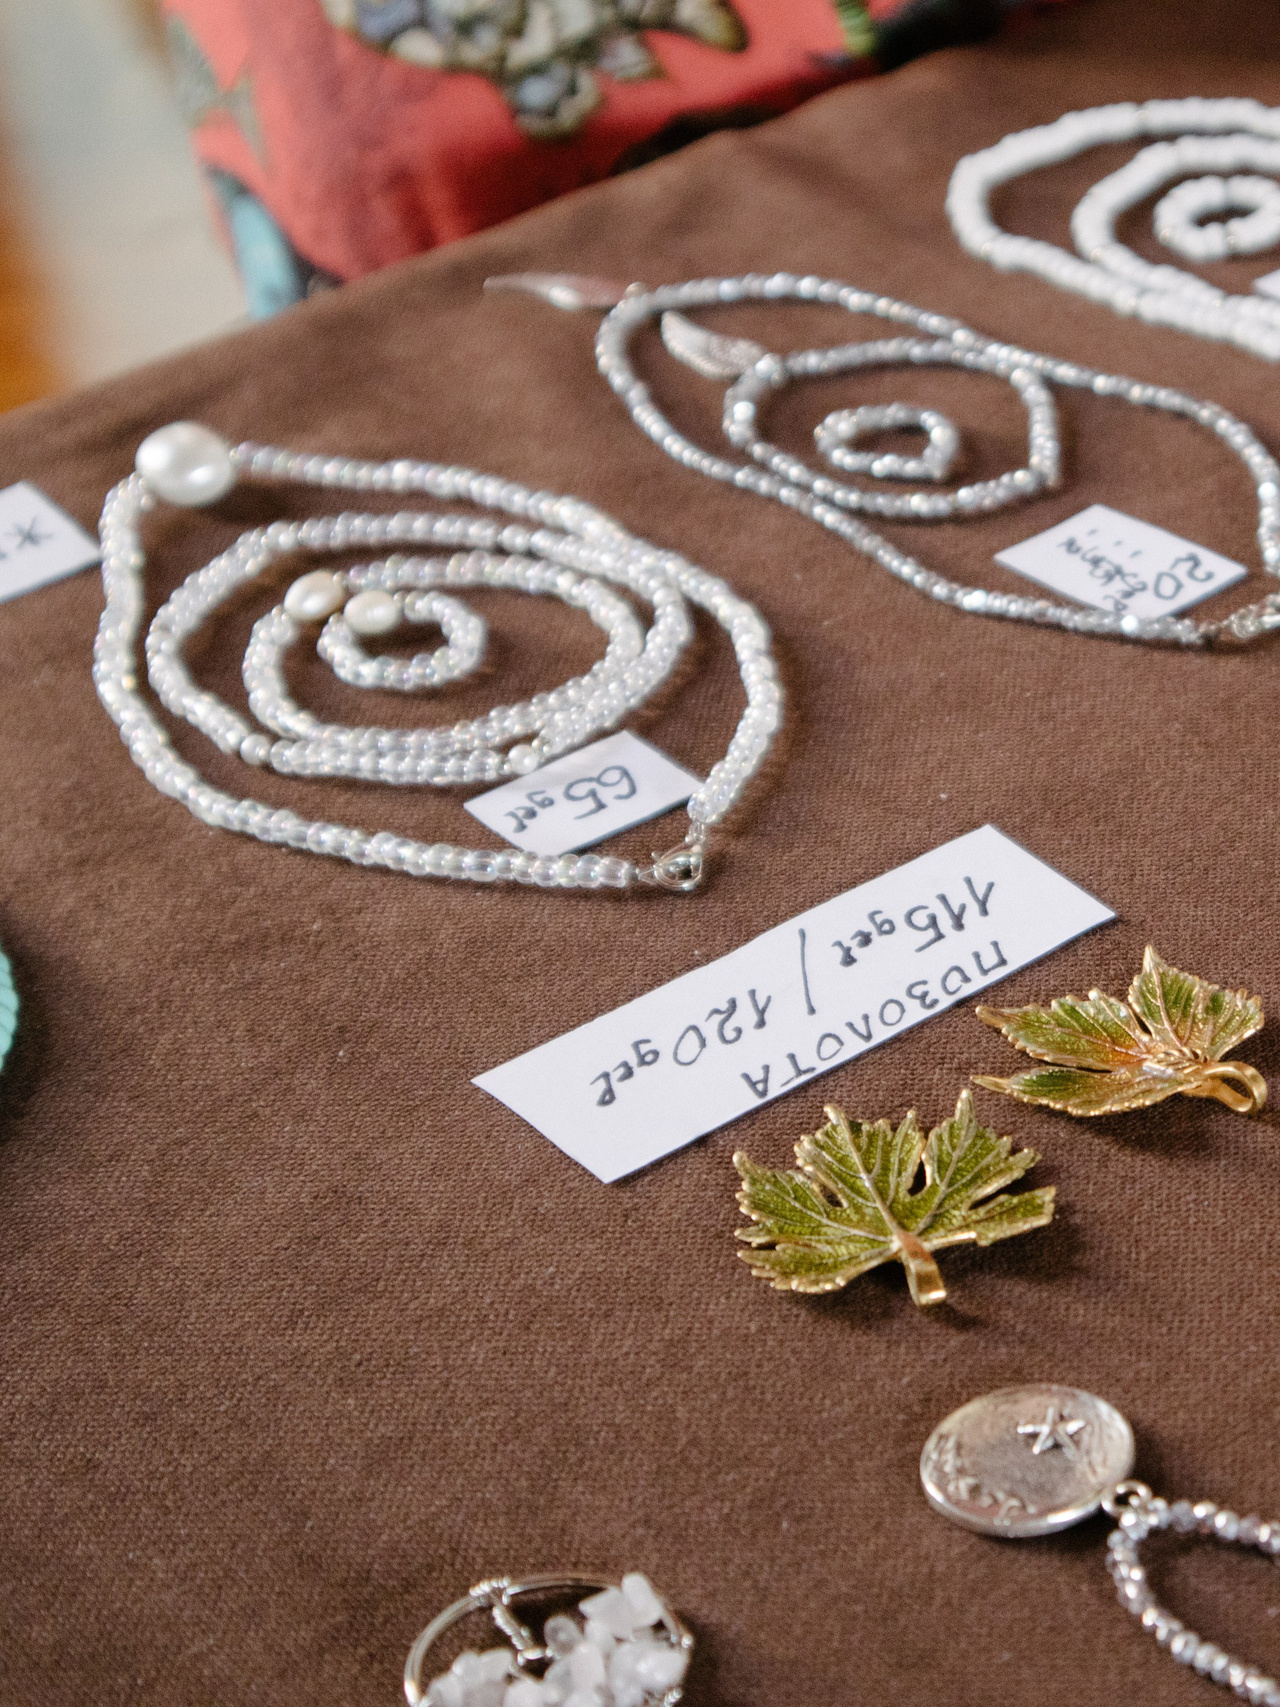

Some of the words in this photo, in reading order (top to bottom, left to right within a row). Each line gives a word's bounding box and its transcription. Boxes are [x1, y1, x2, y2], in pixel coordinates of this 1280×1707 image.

[1154, 551, 1215, 600] 20
[563, 764, 637, 820] 65
[672, 987, 772, 1066] 120
[740, 939, 1008, 1099] ПОЗОЛОТА
